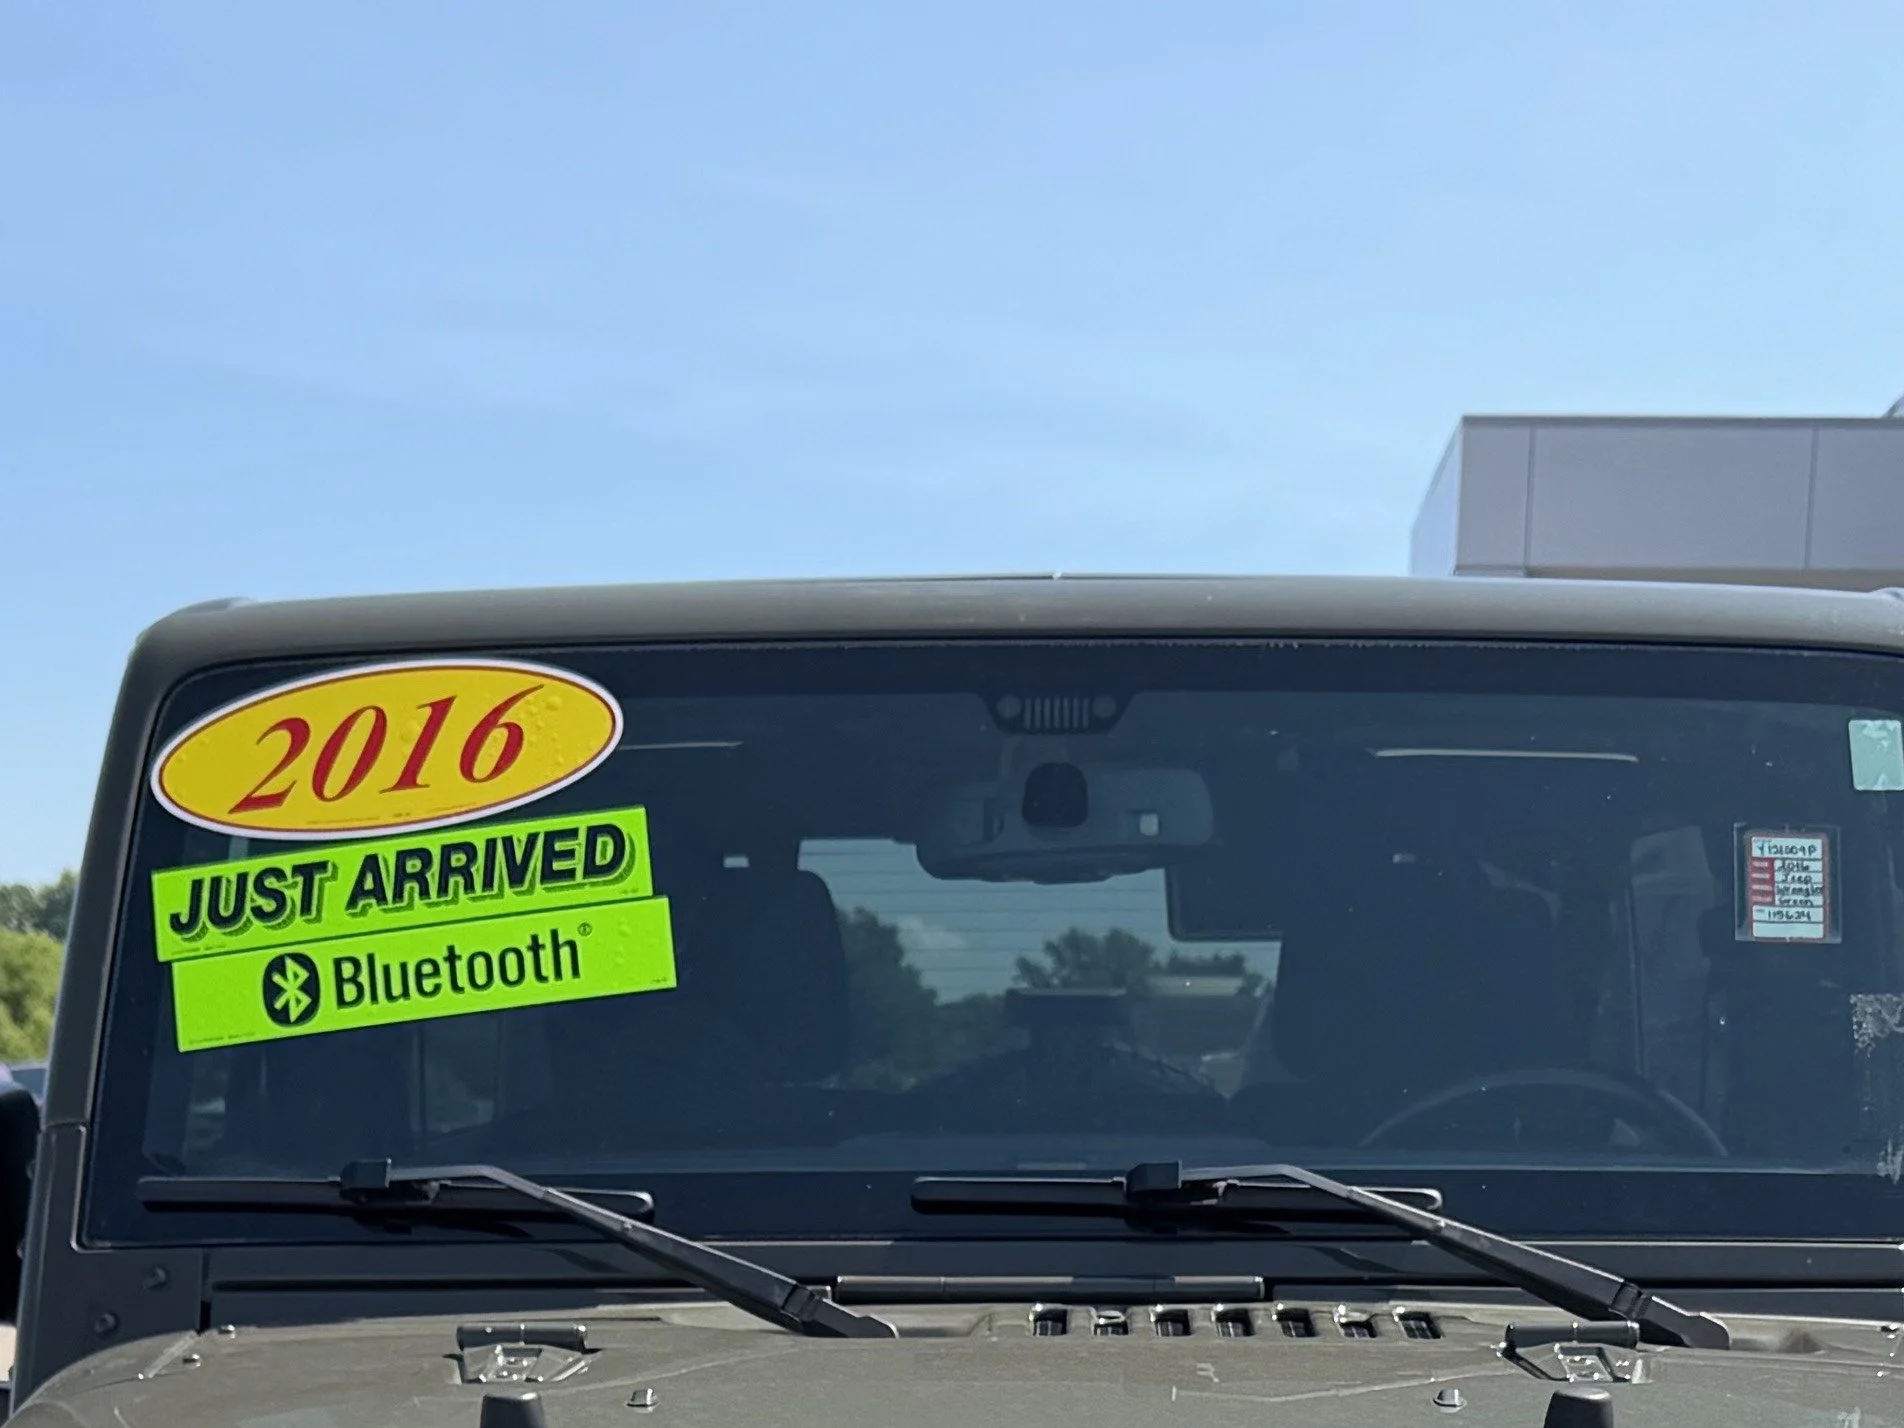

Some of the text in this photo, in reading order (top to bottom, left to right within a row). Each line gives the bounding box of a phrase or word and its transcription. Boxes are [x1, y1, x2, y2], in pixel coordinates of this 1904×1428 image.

[228, 684, 545, 814] 2016
[169, 823, 634, 940] JUST ARRIVED
